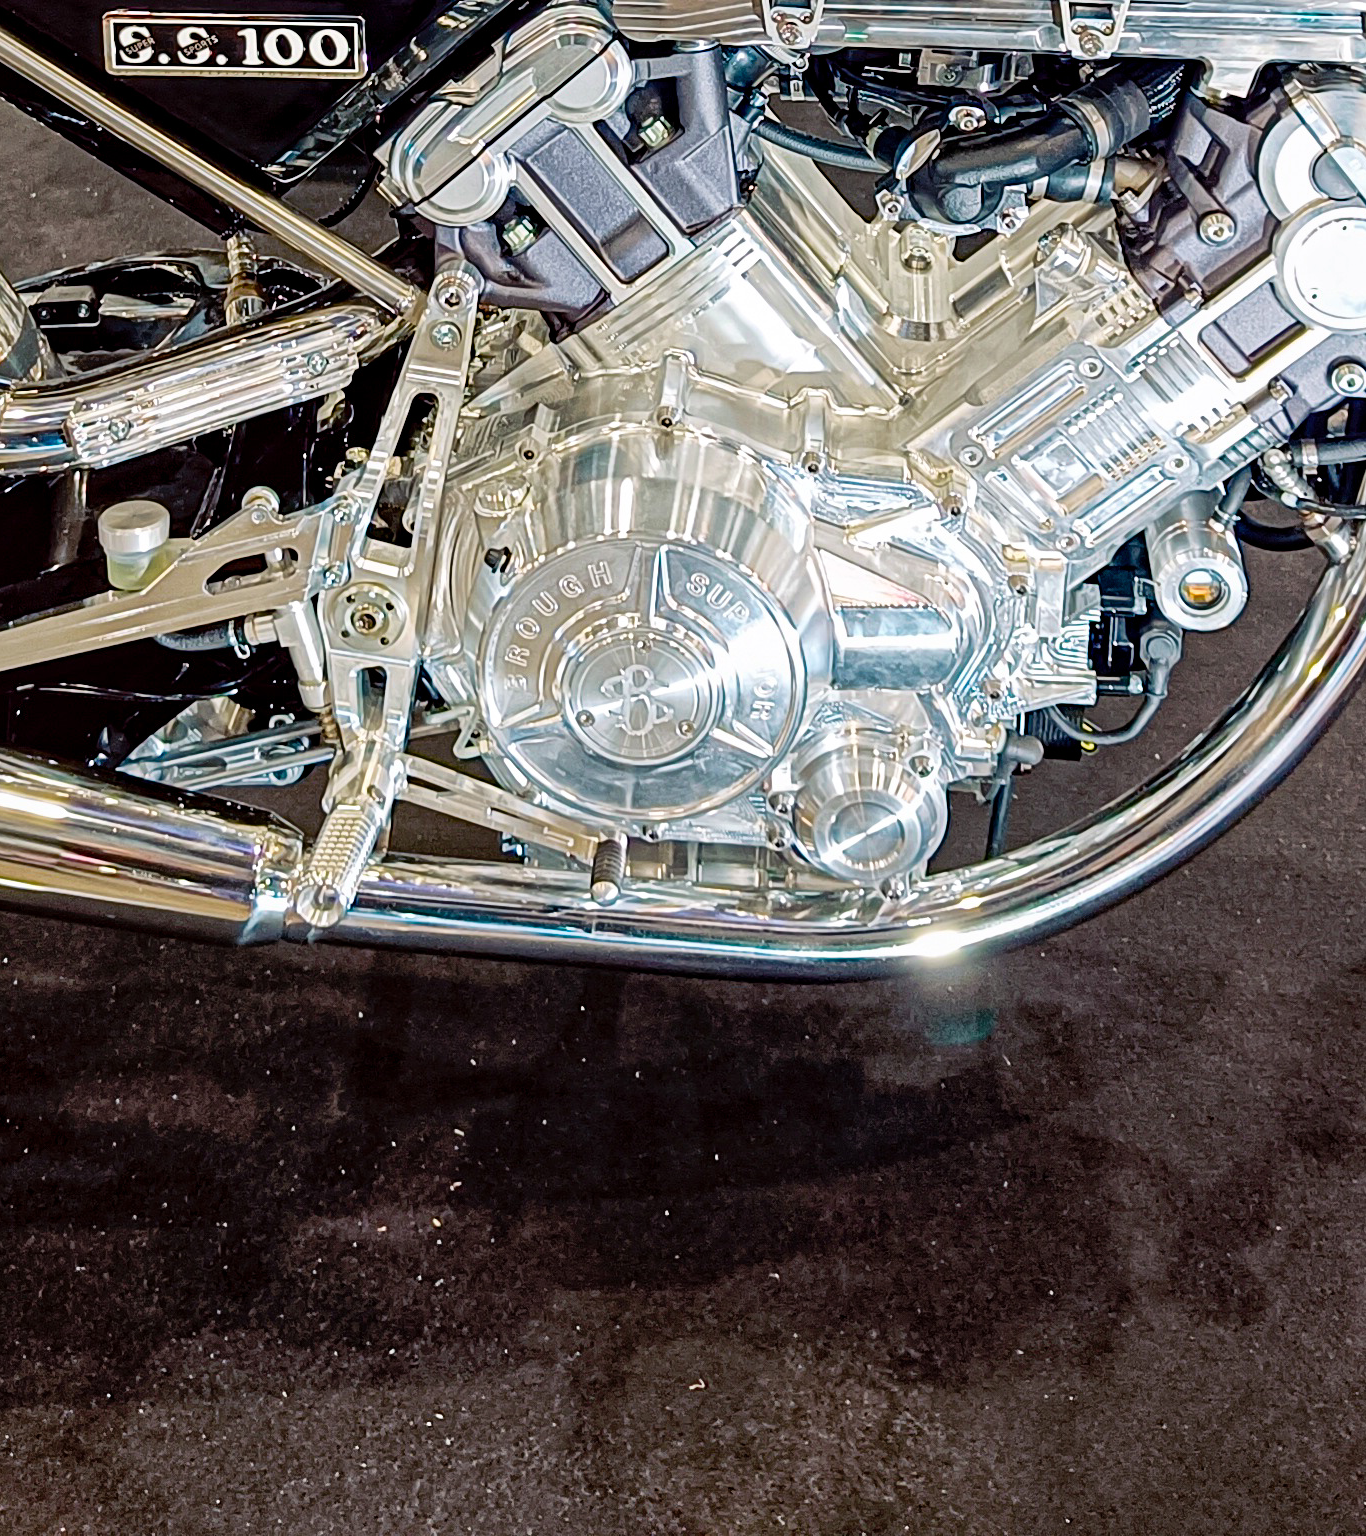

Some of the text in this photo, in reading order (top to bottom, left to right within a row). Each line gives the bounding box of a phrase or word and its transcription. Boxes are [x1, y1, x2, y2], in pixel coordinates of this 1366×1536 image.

[124, 37, 156, 55] SUPER
[183, 35, 219, 57] SPORTS
[503, 560, 614, 692] BROUGH
